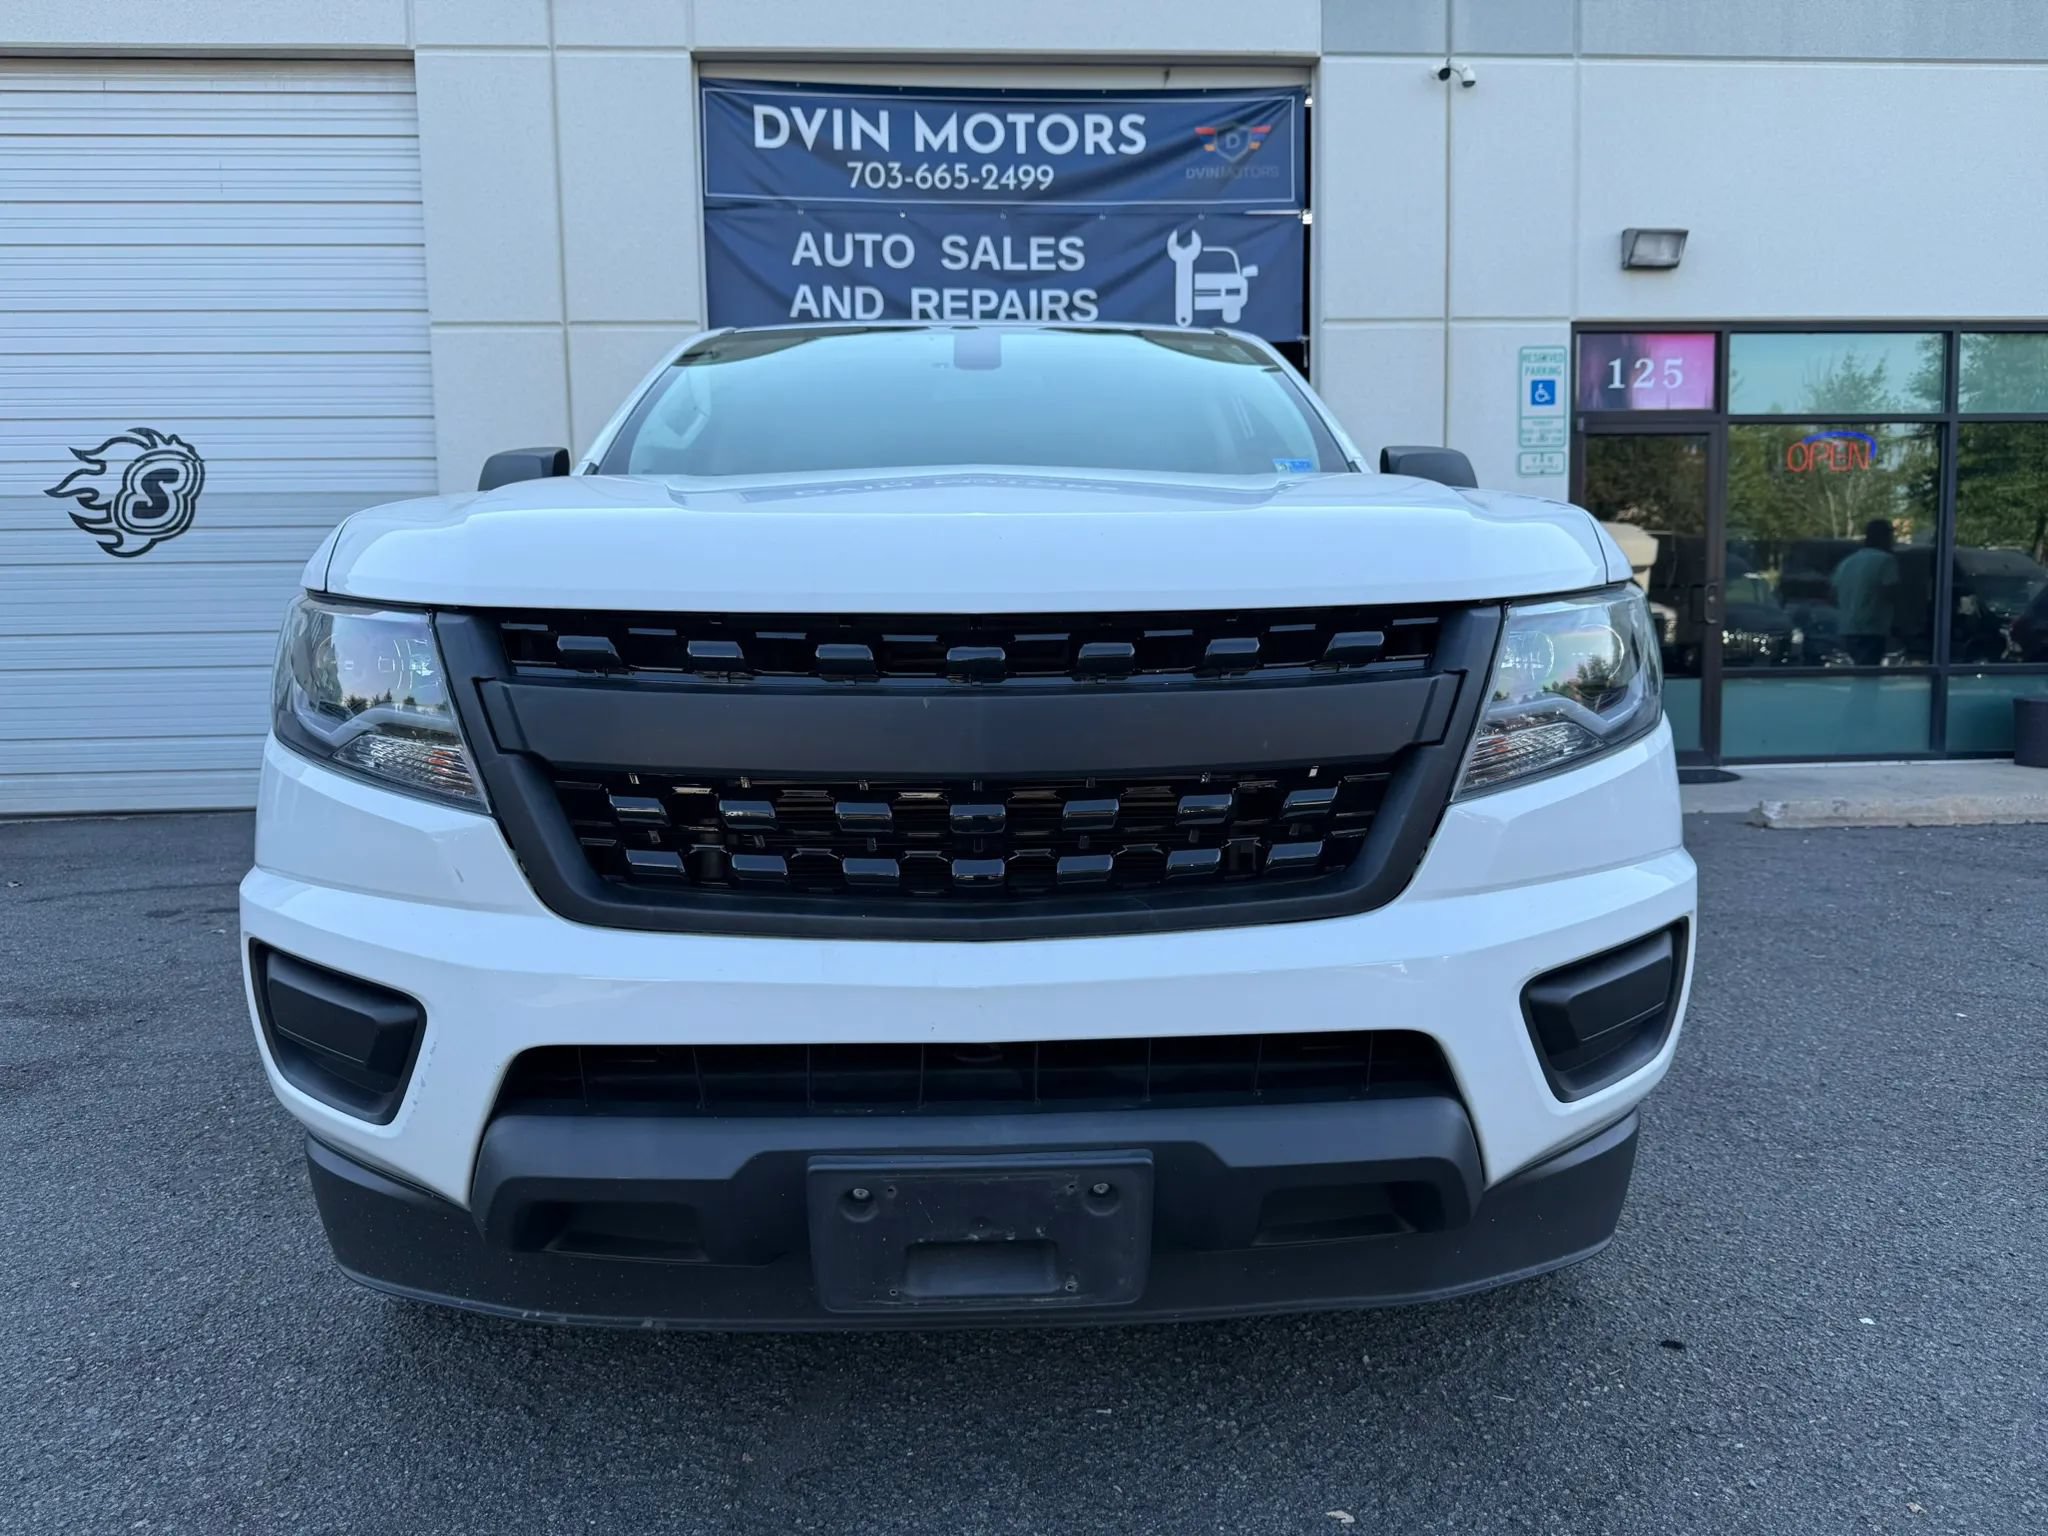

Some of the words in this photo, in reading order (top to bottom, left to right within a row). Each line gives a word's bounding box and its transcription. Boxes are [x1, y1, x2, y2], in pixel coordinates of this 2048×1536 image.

[753, 104, 889, 152] DVIN
[914, 110, 1147, 155] MOTORS
[847, 161, 1055, 191] 703-665-2499
[791, 231, 915, 268] AUTO
[941, 235, 1085, 271] SALES
[789, 284, 884, 320] AND
[911, 287, 1099, 322] REPAIRS
[1607, 358, 1684, 389] 125
[1786, 441, 1870, 472] OPEN
